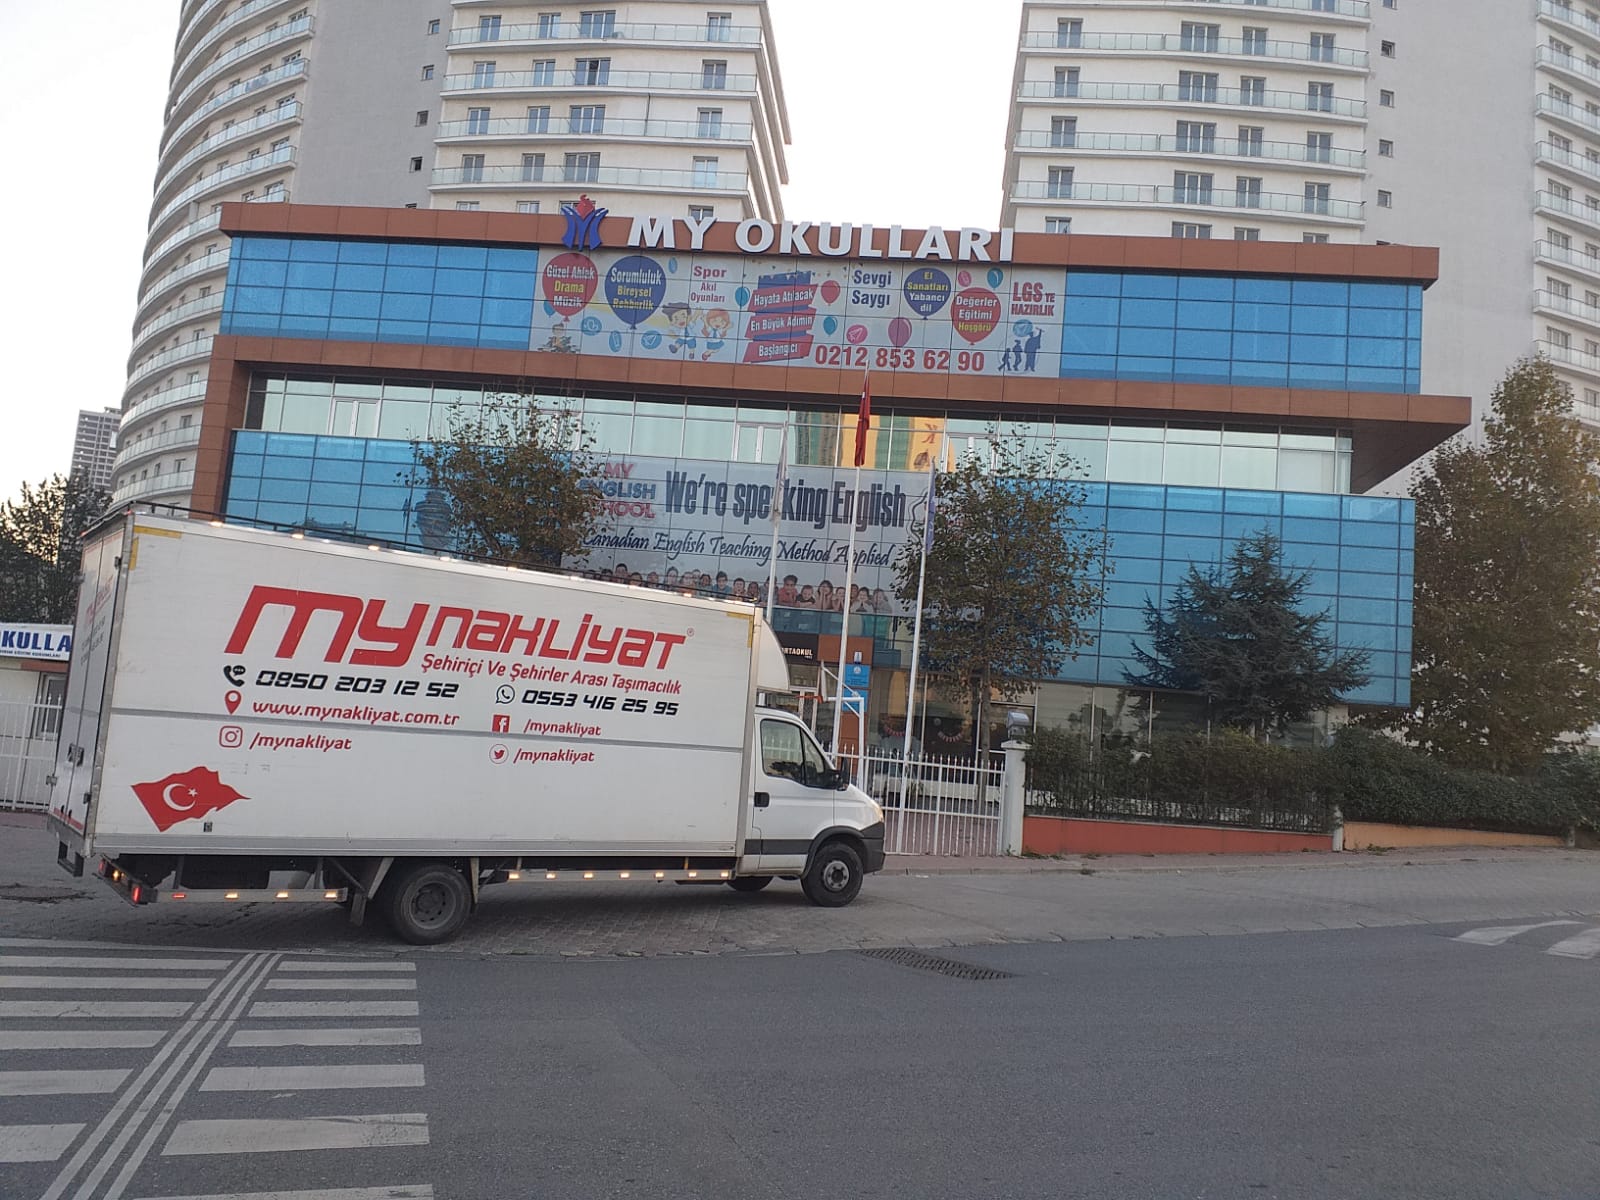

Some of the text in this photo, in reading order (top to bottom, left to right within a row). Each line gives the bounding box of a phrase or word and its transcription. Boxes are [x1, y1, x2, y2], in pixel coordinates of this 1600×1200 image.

[627, 215, 1014, 263] MY OKULLARI
[546, 265, 595, 280] Güzel Ahlak
[610, 267, 662, 286] Sorumluluk
[693, 265, 728, 280] Spor
[853, 270, 892, 288] Sevgi
[554, 280, 584, 293] Drama
[617, 285, 652, 298] Bireysel
[700, 282, 717, 292] Akıl
[906, 282, 948, 291] Sanatları
[1013, 281, 1044, 303] LGS
[553, 295, 582, 307] Müzik
[691, 292, 726, 303] Oyunları
[753, 293, 780, 307] Hayata
[852, 289, 891, 309] Saygı
[909, 293, 945, 302] Yabancı
[956, 295, 998, 308] Değerler
[920, 304, 932, 312] dil
[958, 309, 993, 321] Eğitimi
[1011, 303, 1054, 316] HAZIRLIK
[751, 320, 760, 331] En
[762, 317, 785, 331] Büyük
[958, 322, 991, 333] Hoşgörü
[815, 345, 985, 372] 0212 853 62 90
[605, 462, 634, 479] MY
[665, 470, 728, 517] We're
[733, 479, 829, 530] speking
[831, 480, 907, 532] English
[653, 530, 706, 561] English
[710, 534, 772, 567] Teaching
[776, 539, 837, 563] Method
[0, 630, 70, 652] KULLA
[421, 653, 682, 695] Şehiriçi Ve Şehirler Arası Taşımacılık
[255, 669, 460, 698] 0850 203 12 52
[521, 689, 679, 716] 0553 416 25 95
[252, 701, 460, 726] www.mynakliyat.com.tr
[523, 718, 602, 736] /mynakliyat
[249, 732, 353, 753] /mynakliyat
[513, 748, 595, 764] /mynakliyat
